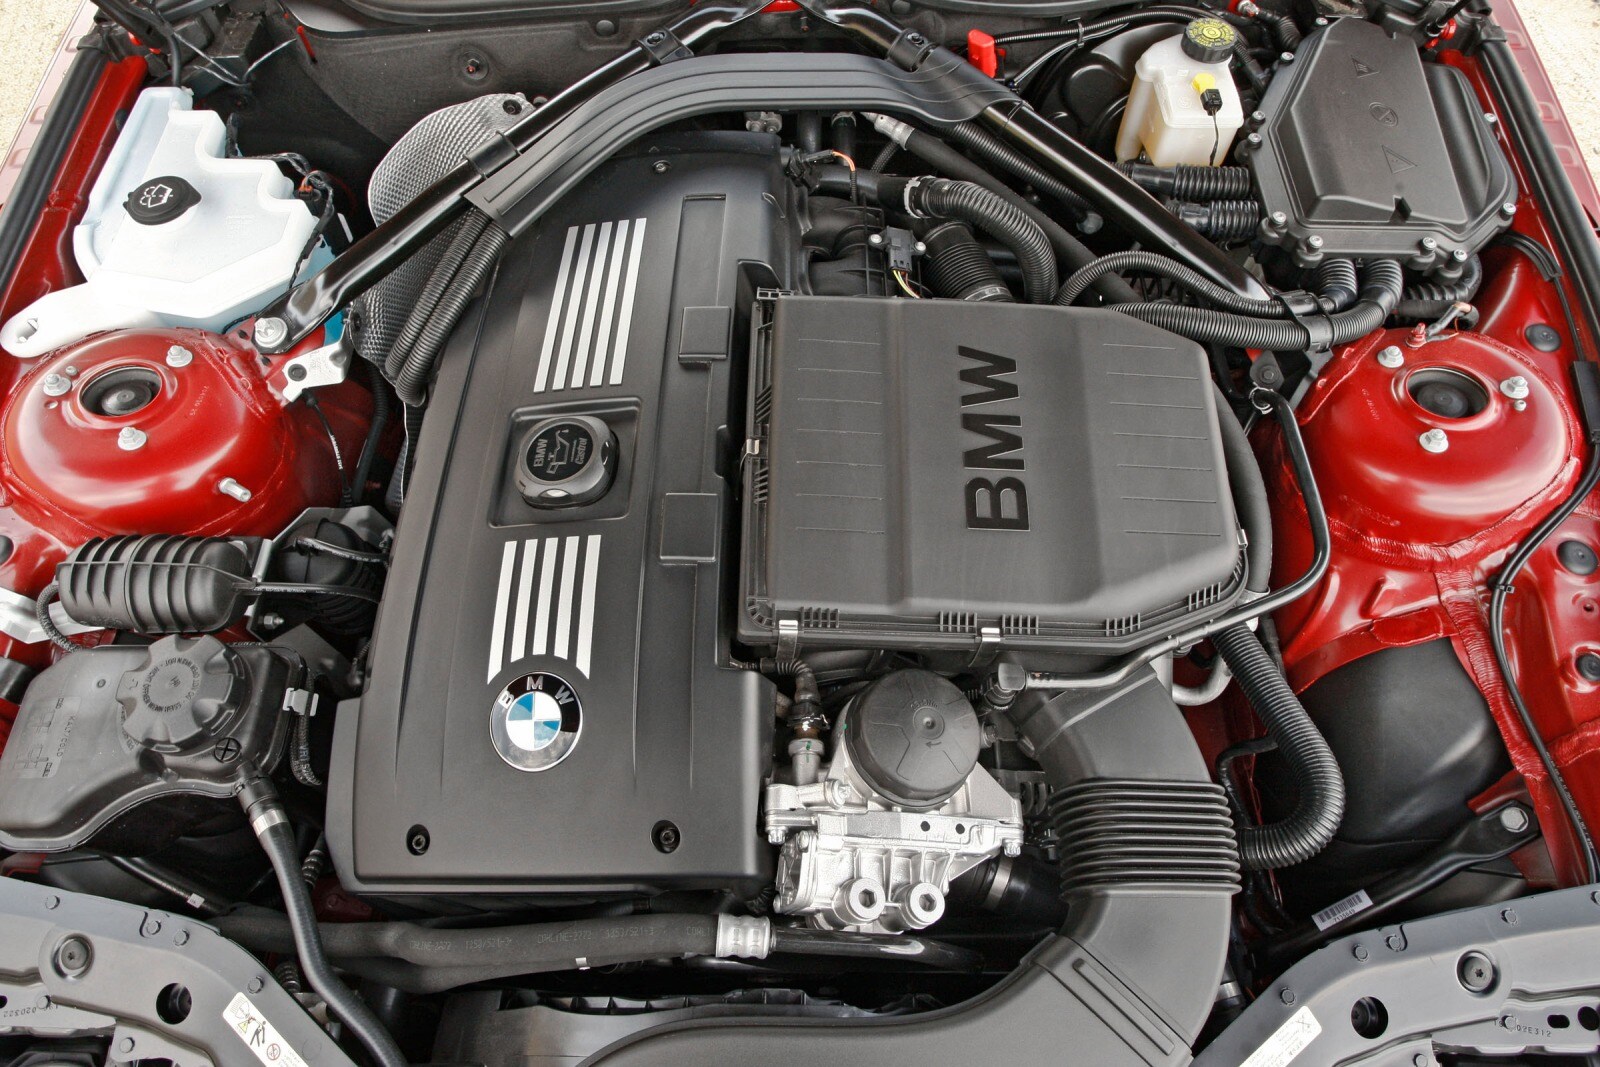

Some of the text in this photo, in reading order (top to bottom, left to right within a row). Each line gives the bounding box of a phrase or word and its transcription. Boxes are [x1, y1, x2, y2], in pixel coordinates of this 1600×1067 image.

[532, 438, 549, 468] BMW
[574, 437, 588, 465] Castrol
[957, 345, 1030, 531] BMW
[498, 675, 574, 710] BMW
